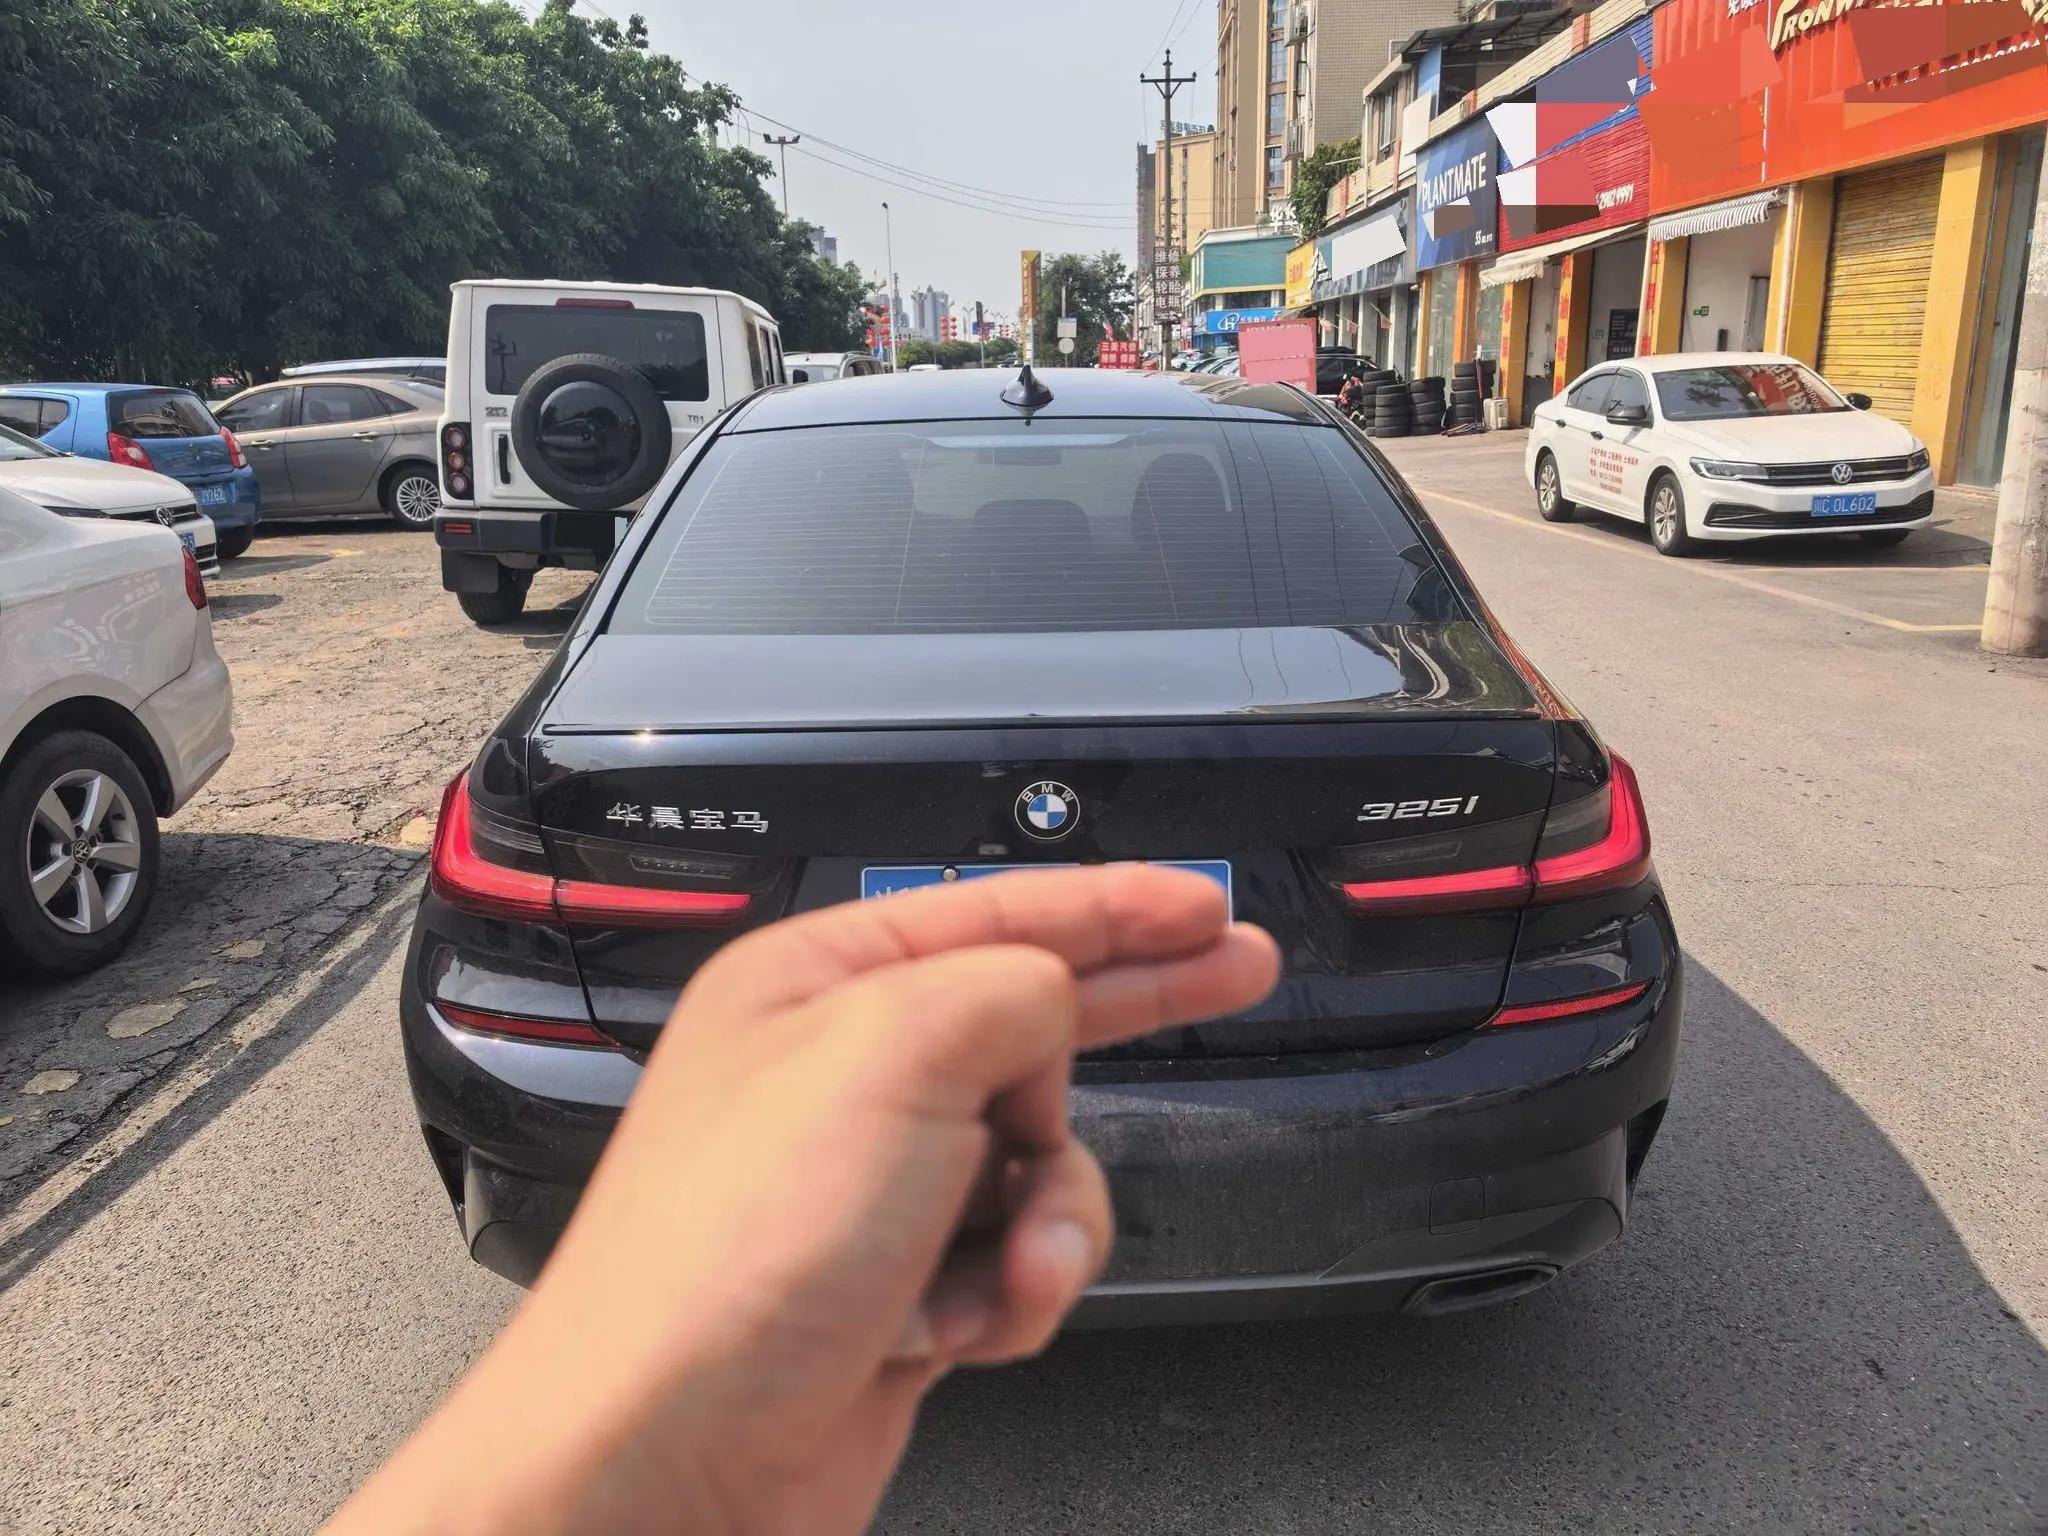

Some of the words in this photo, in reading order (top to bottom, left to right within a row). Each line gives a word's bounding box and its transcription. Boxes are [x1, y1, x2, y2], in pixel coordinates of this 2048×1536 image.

[1421, 152, 1487, 212] PLANTMATE
[1155, 265, 1181, 279] 保养
[1155, 280, 1181, 294] 轮胎
[1021, 783, 1075, 803] BMW
[606, 802, 769, 834] 华晨宝马
